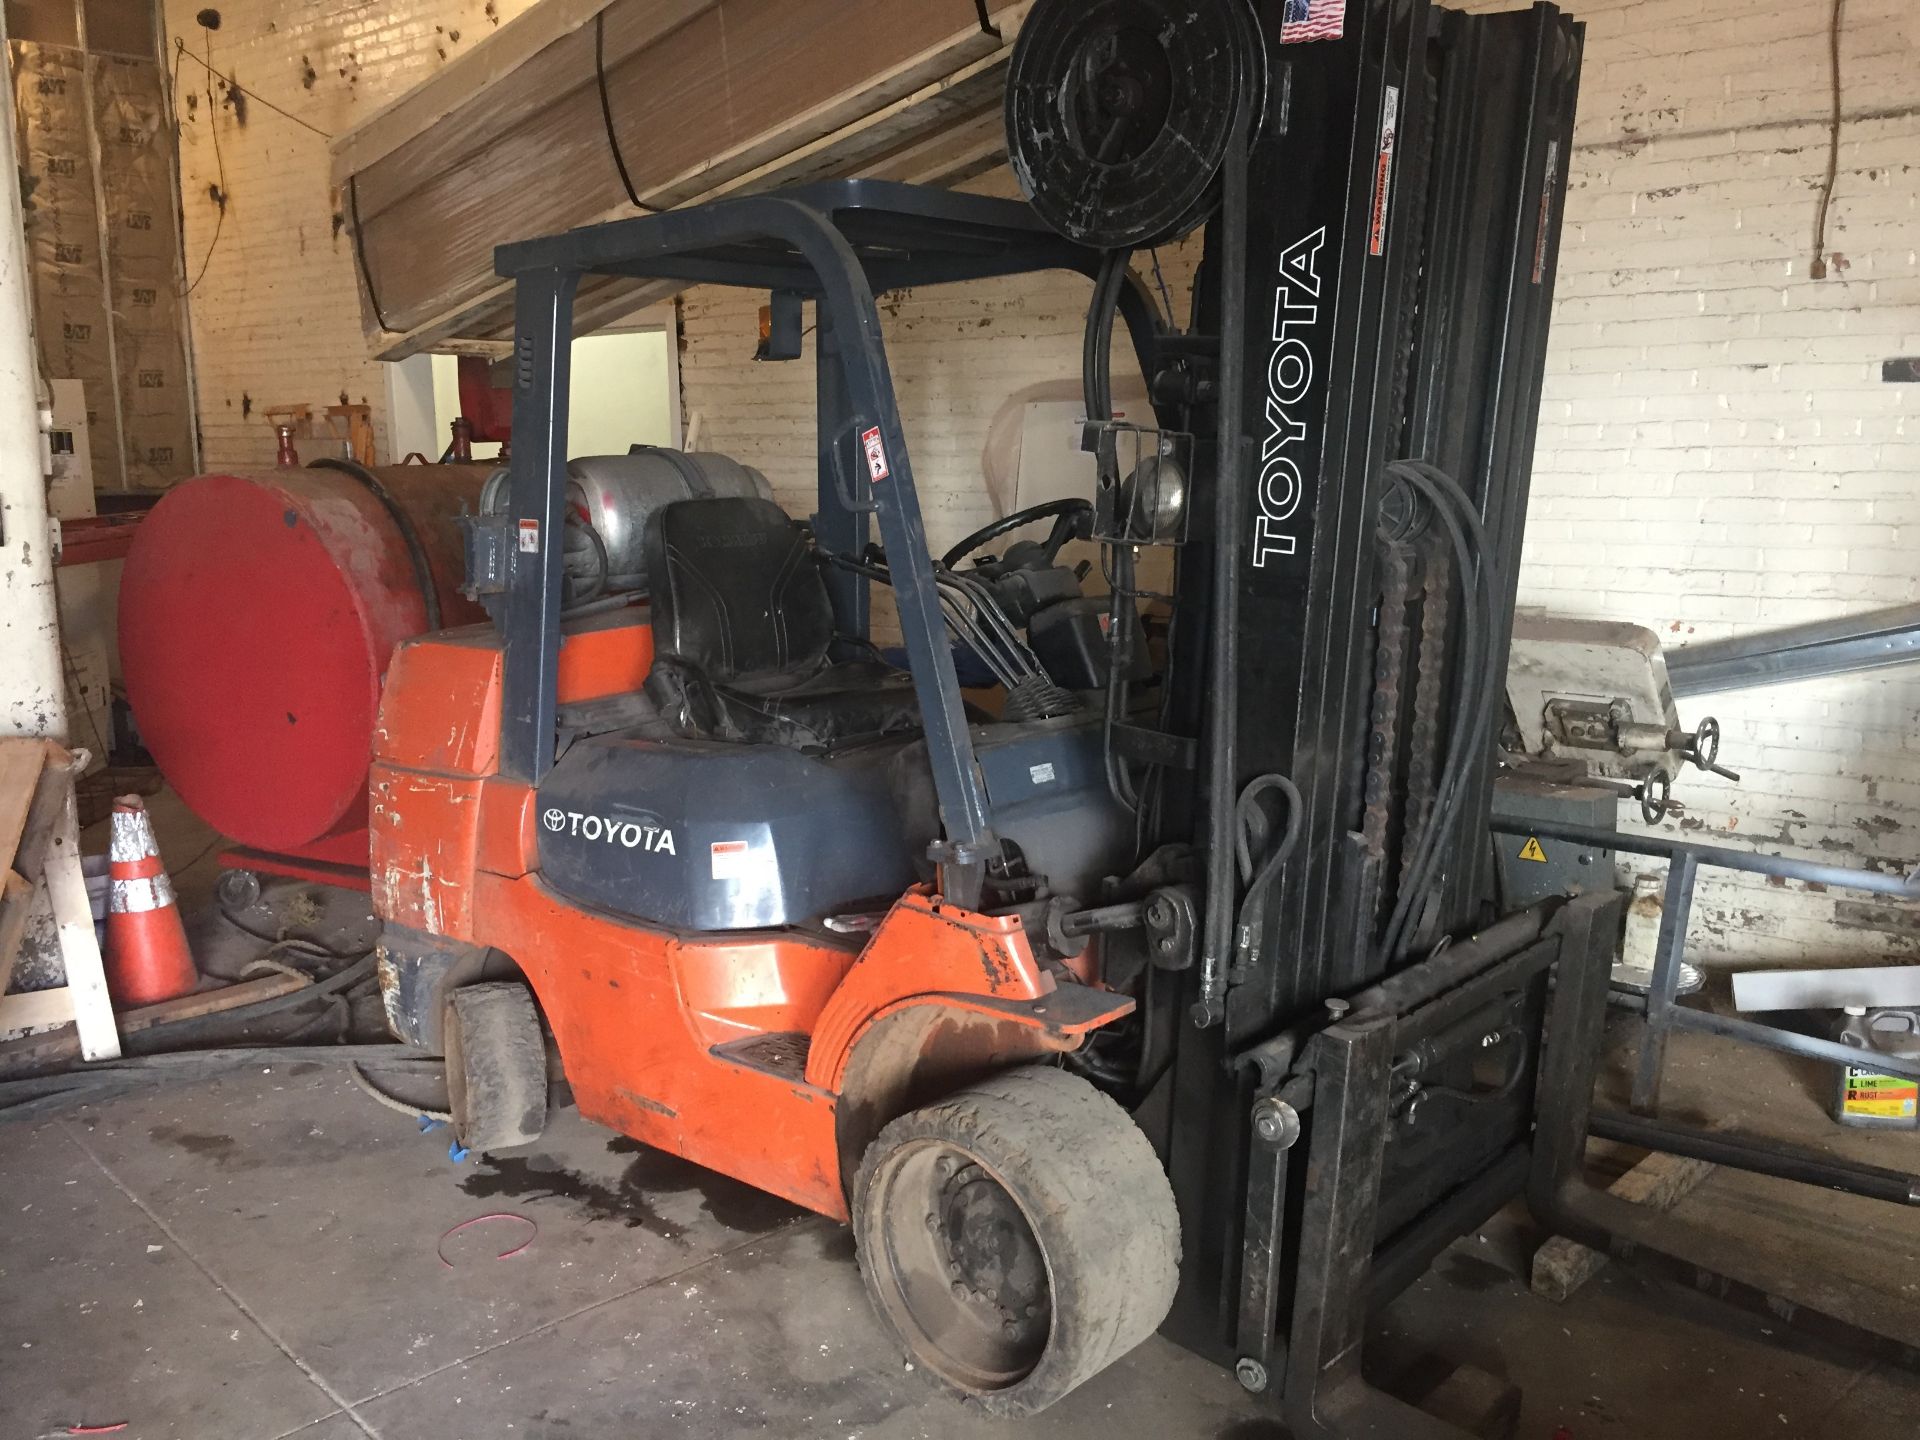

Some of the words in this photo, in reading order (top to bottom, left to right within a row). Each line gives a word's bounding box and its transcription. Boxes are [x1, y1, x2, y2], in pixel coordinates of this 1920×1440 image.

[1375, 163, 1387, 225] WARNING
[1253, 225, 1326, 568] TOYOTA
[567, 811, 677, 856] TOYOTA
[1848, 1090, 1858, 1100] R
[1849, 1079, 1858, 1089] L
[1860, 1080, 1878, 1088] LIME
